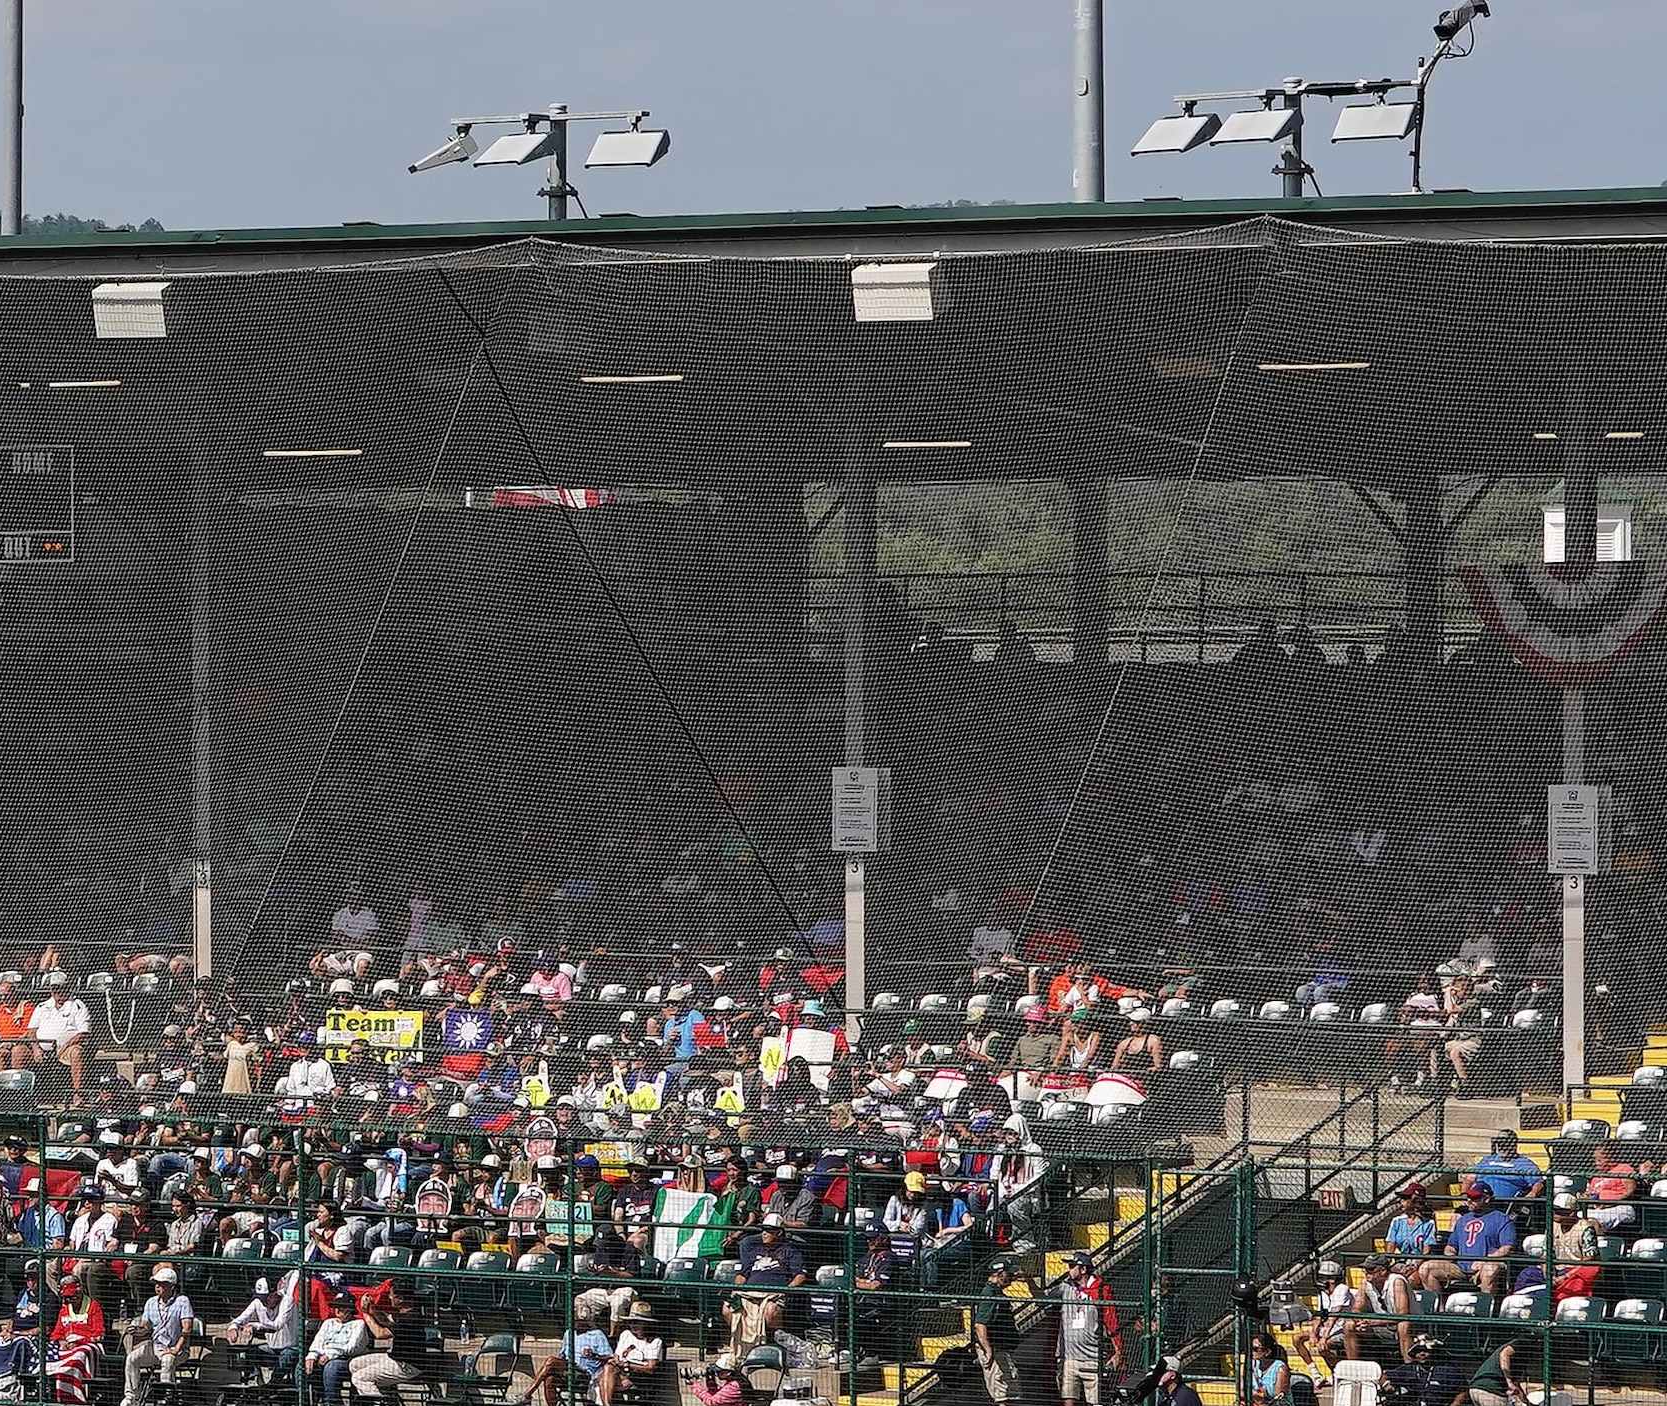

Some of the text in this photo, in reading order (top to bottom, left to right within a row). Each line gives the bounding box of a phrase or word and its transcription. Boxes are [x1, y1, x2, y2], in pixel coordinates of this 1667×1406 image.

[12, 452, 54, 473] HOME
[3, 537, 32, 558] OUT
[1569, 875, 1579, 889] 3
[328, 1012, 396, 1032] Team
[1320, 1190, 1341, 1207] EXIT
[1465, 1219, 1484, 1248] P
